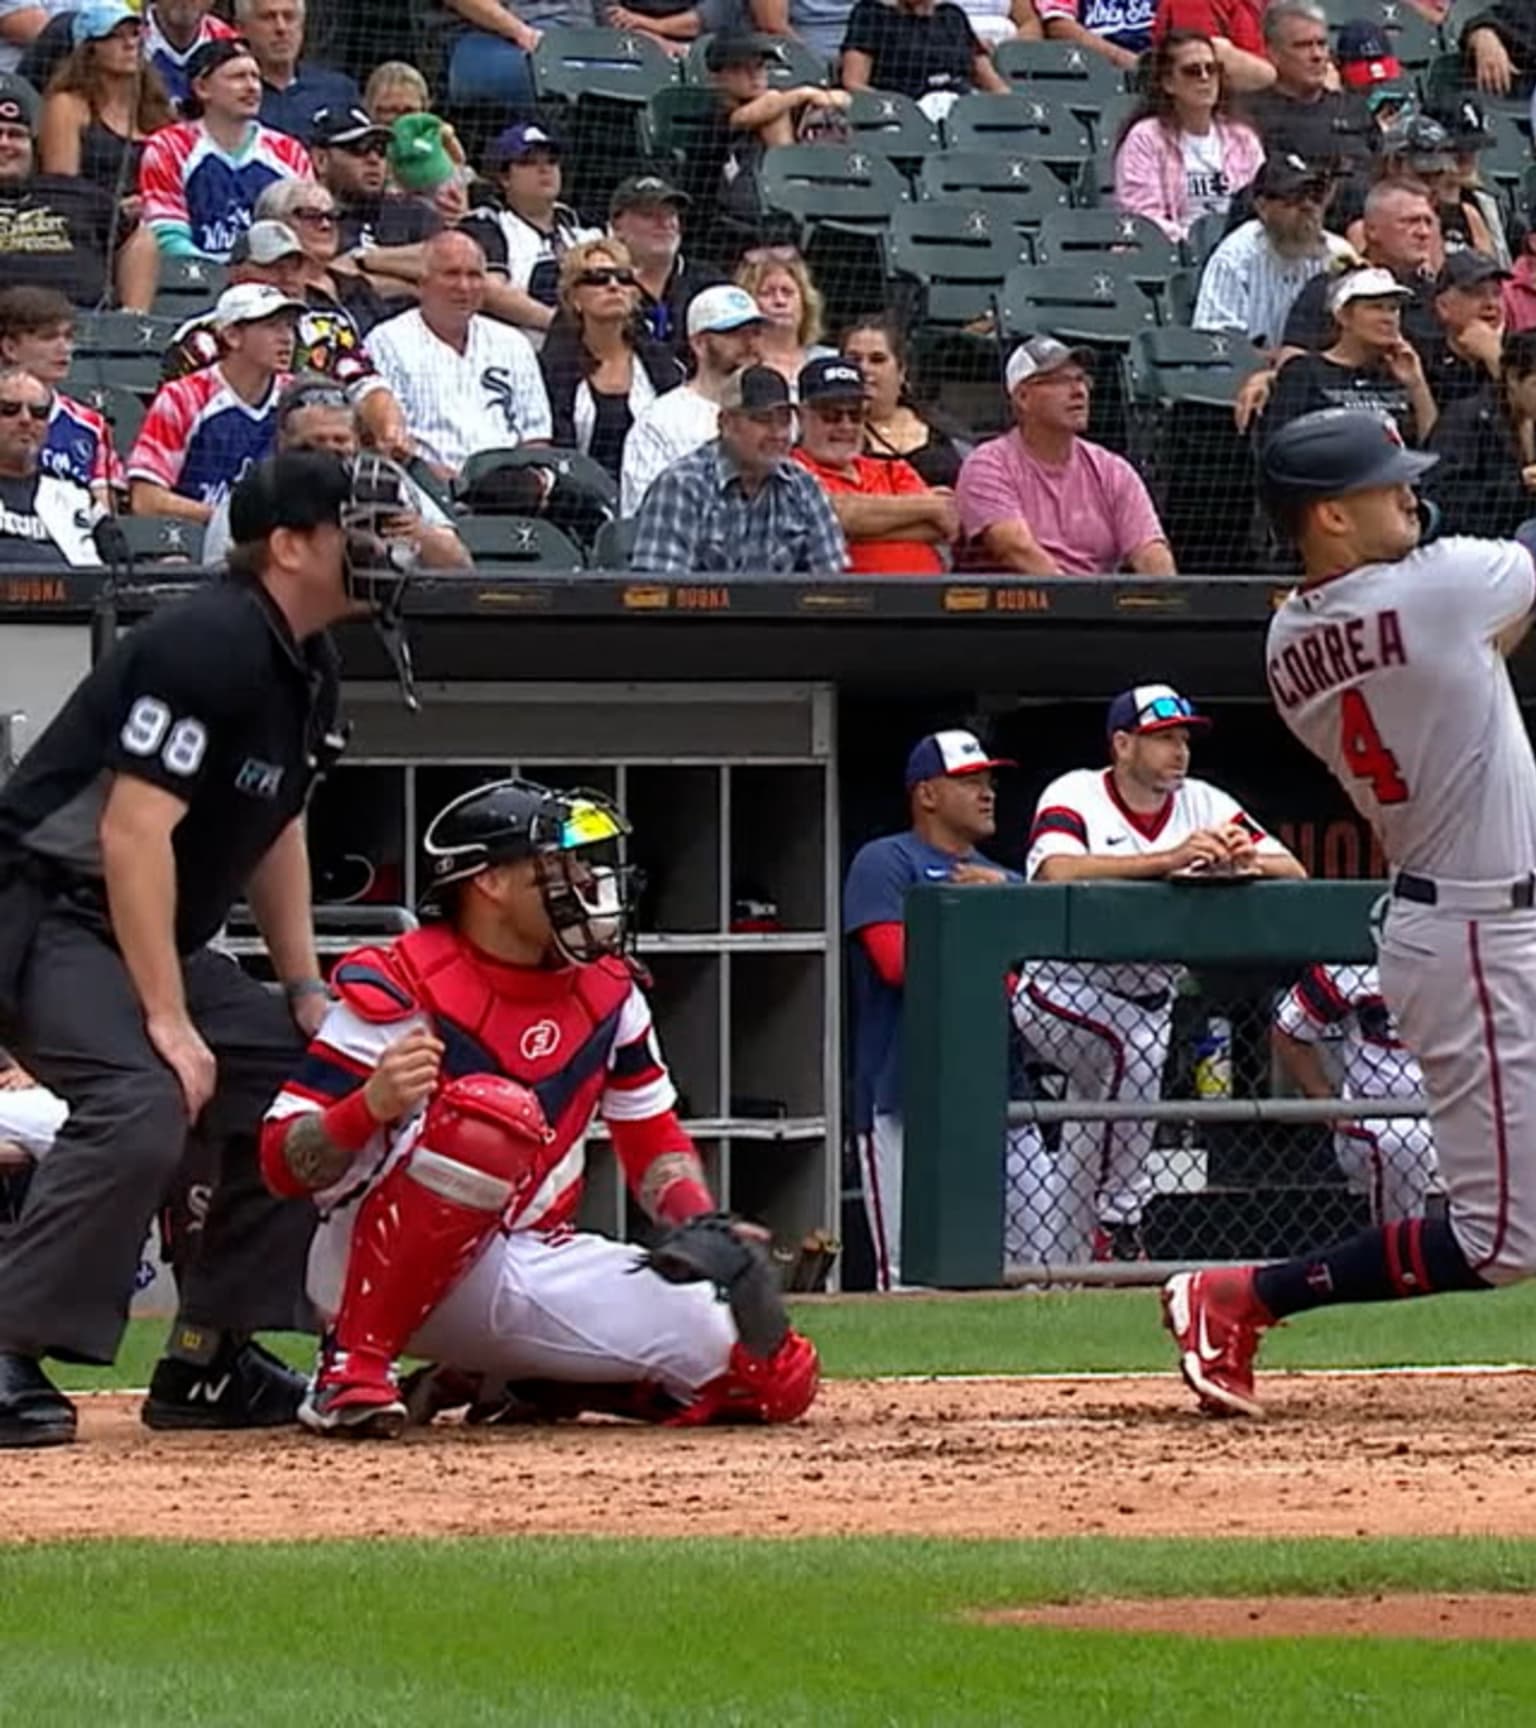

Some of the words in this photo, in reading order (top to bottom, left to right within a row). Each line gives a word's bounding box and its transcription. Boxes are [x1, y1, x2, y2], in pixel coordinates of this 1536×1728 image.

[1269, 611, 1408, 709] CORREA
[120, 695, 207, 775] 98
[1341, 688, 1410, 805] 4
